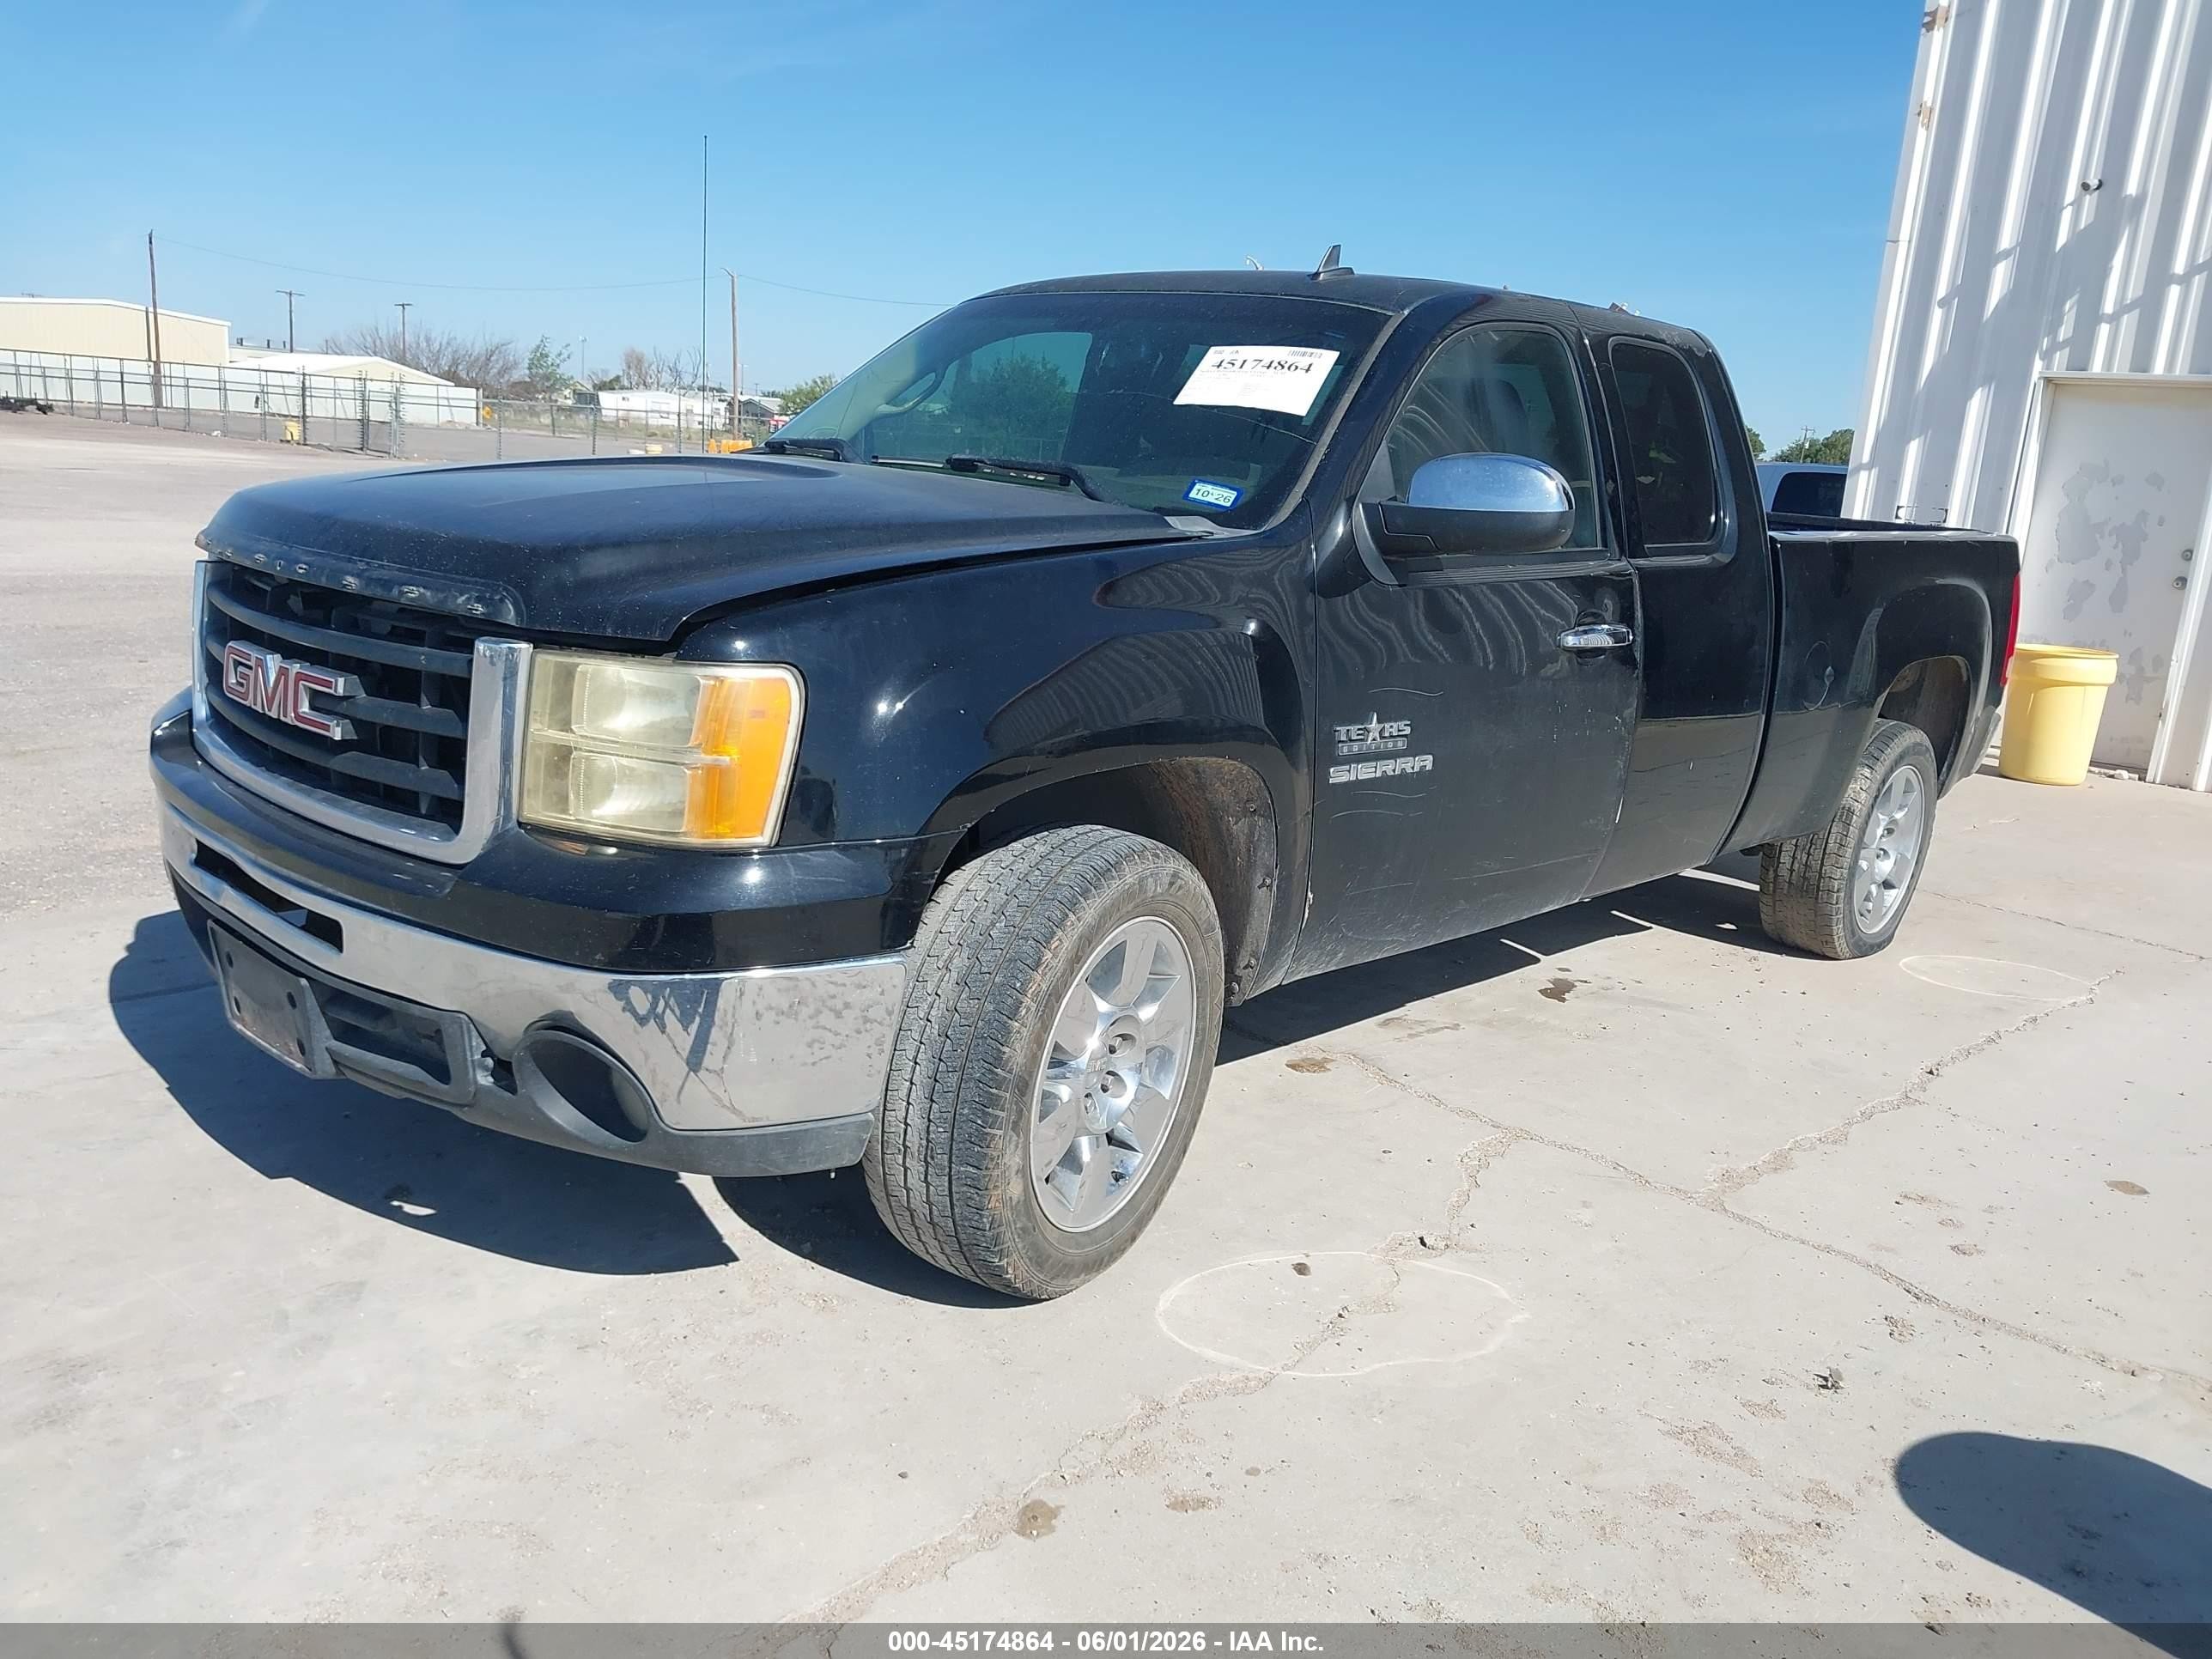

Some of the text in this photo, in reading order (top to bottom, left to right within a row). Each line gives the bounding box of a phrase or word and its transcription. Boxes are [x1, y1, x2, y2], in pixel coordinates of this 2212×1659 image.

[1211, 357, 1315, 374] 45174864
[1194, 488, 1211, 498] 10
[1214, 493, 1232, 503] 26
[222, 640, 356, 741] GMC
[1333, 713, 1412, 743] TEXAS
[1328, 755, 1434, 784] SIERRA
